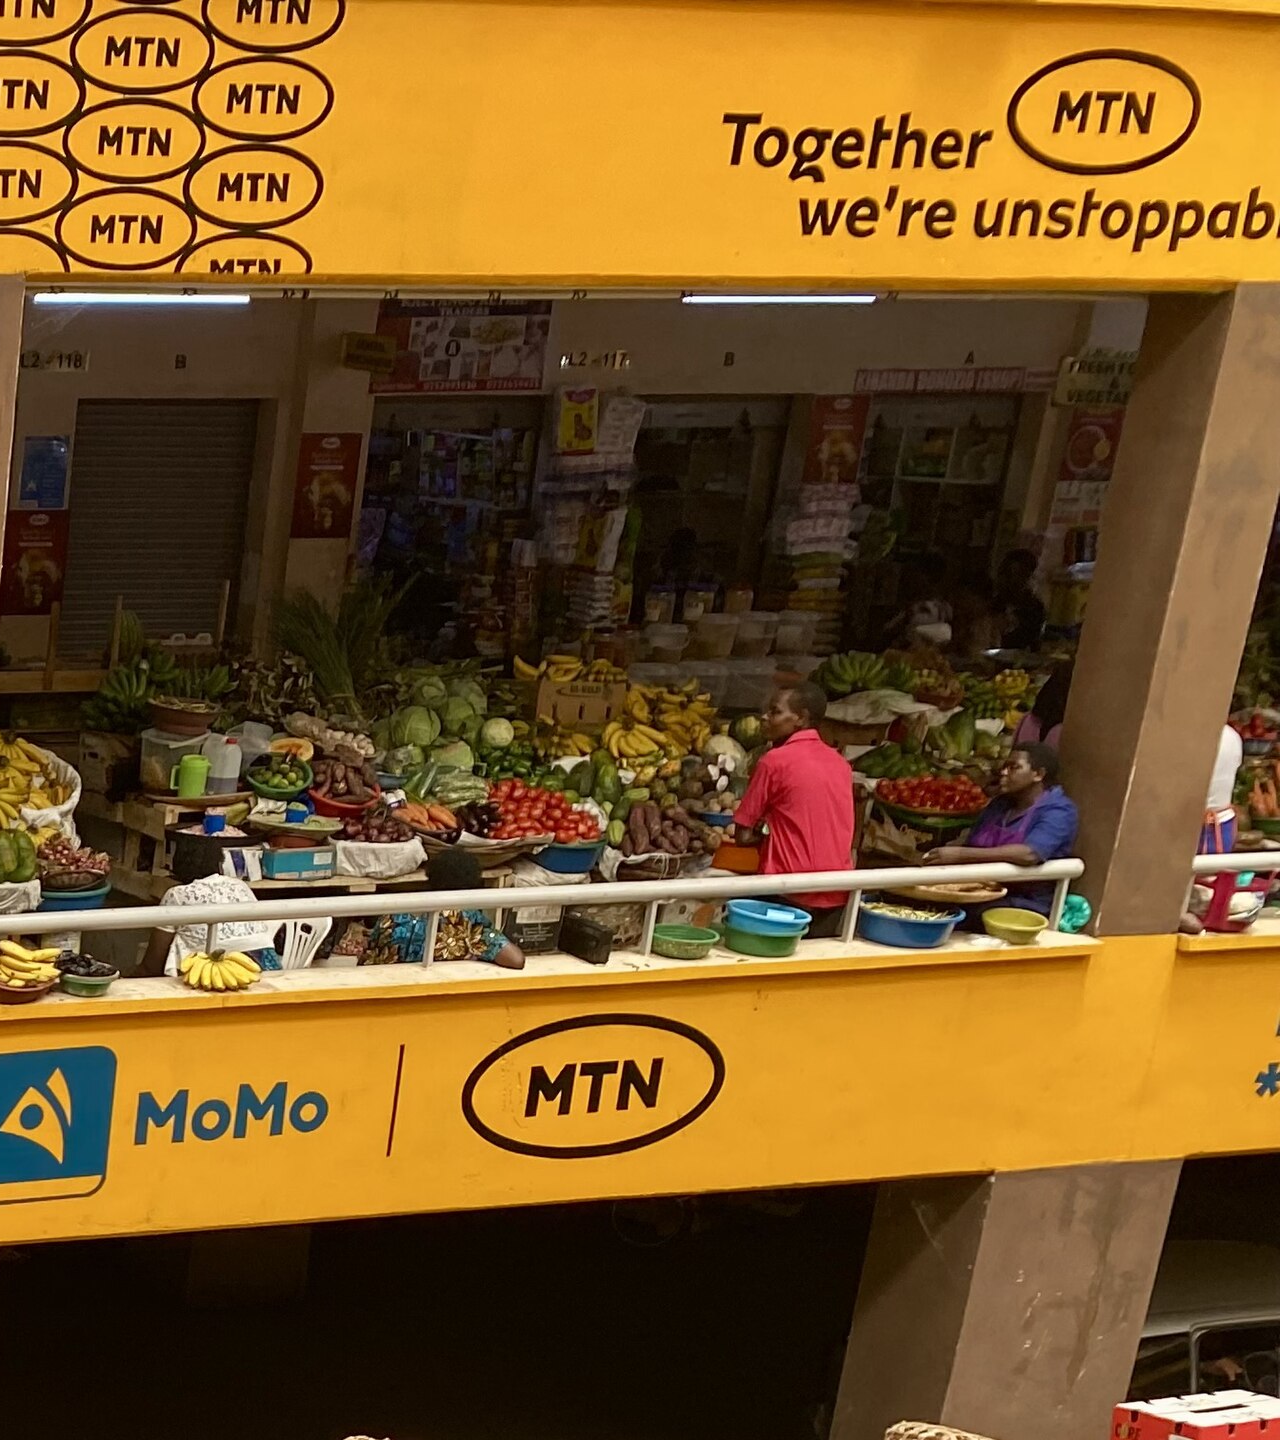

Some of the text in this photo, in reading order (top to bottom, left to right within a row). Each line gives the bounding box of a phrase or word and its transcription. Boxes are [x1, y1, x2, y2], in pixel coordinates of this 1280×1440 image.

[105, 36, 180, 68] MTN
[226, 83, 301, 115] MTN
[98, 126, 171, 157] MTN
[723, 91, 1157, 183] Together MTN
[216, 173, 290, 203] MTN
[90, 215, 164, 245] MTN
[798, 185, 1280, 253] we're unstoppab
[58, 353, 83, 369] 118
[964, 351, 975, 365] A
[523, 1056, 665, 1118] MTN
[134, 1081, 329, 1145] MoMo
